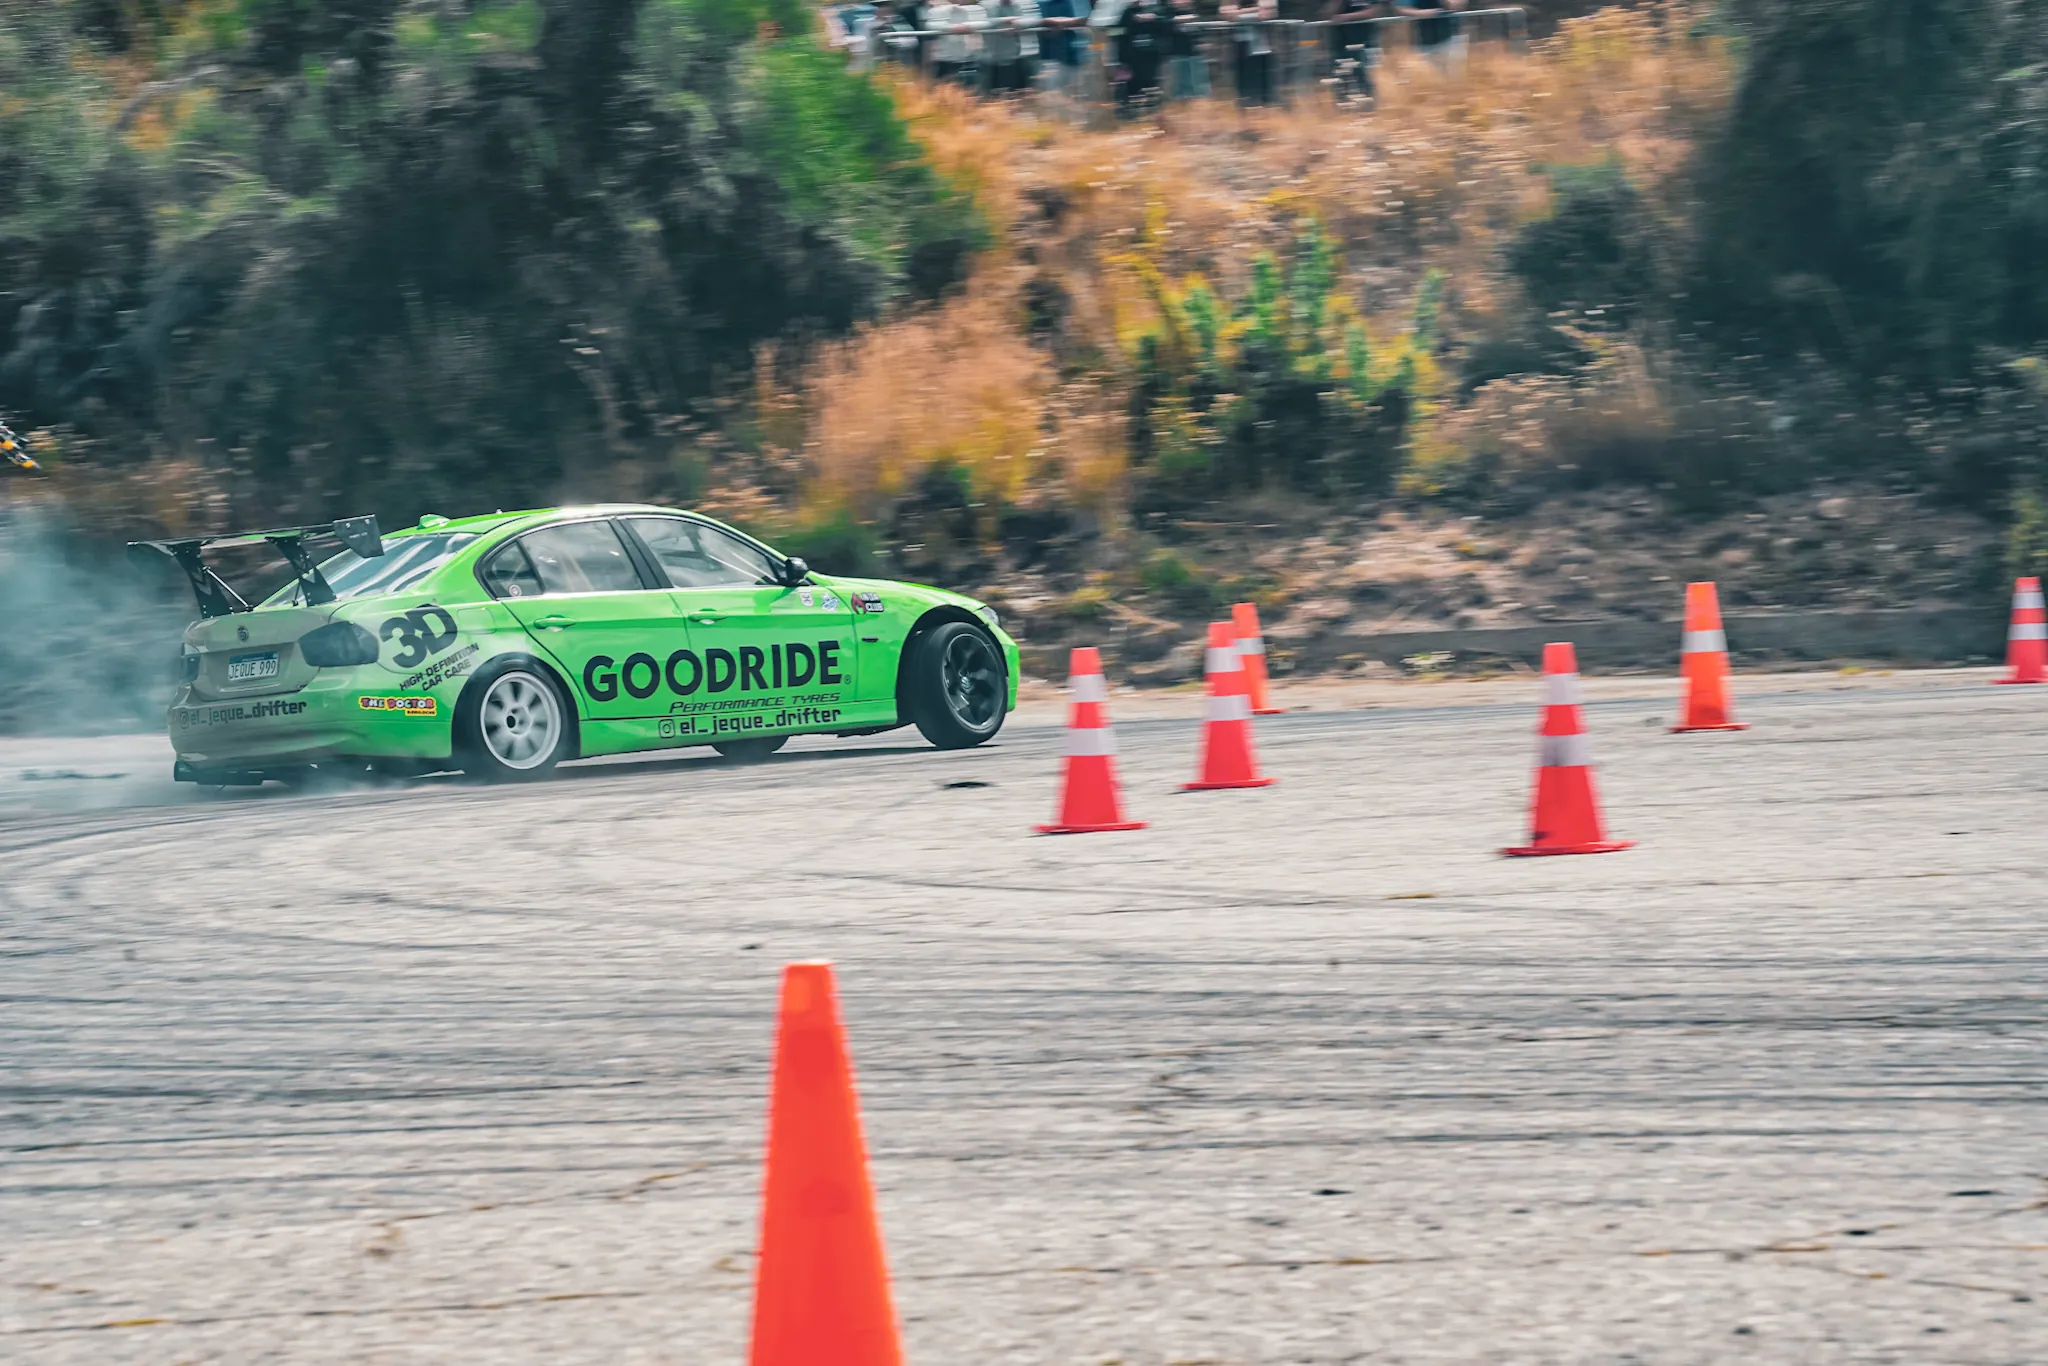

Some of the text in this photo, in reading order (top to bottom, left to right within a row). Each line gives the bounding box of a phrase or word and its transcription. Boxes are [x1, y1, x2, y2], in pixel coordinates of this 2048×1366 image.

[379, 603, 458, 669] 3D
[229, 660, 277, 679] JEQUE 999
[399, 642, 480, 692] HIGH DEFINITION
[421, 660, 472, 692] CAR CARE
[583, 640, 844, 702] GOODRIDE
[360, 697, 435, 710] THE DOCTOR
[669, 692, 841, 714] PERFORMANCE TYRES
[679, 707, 842, 736] el_jeque_drifter
